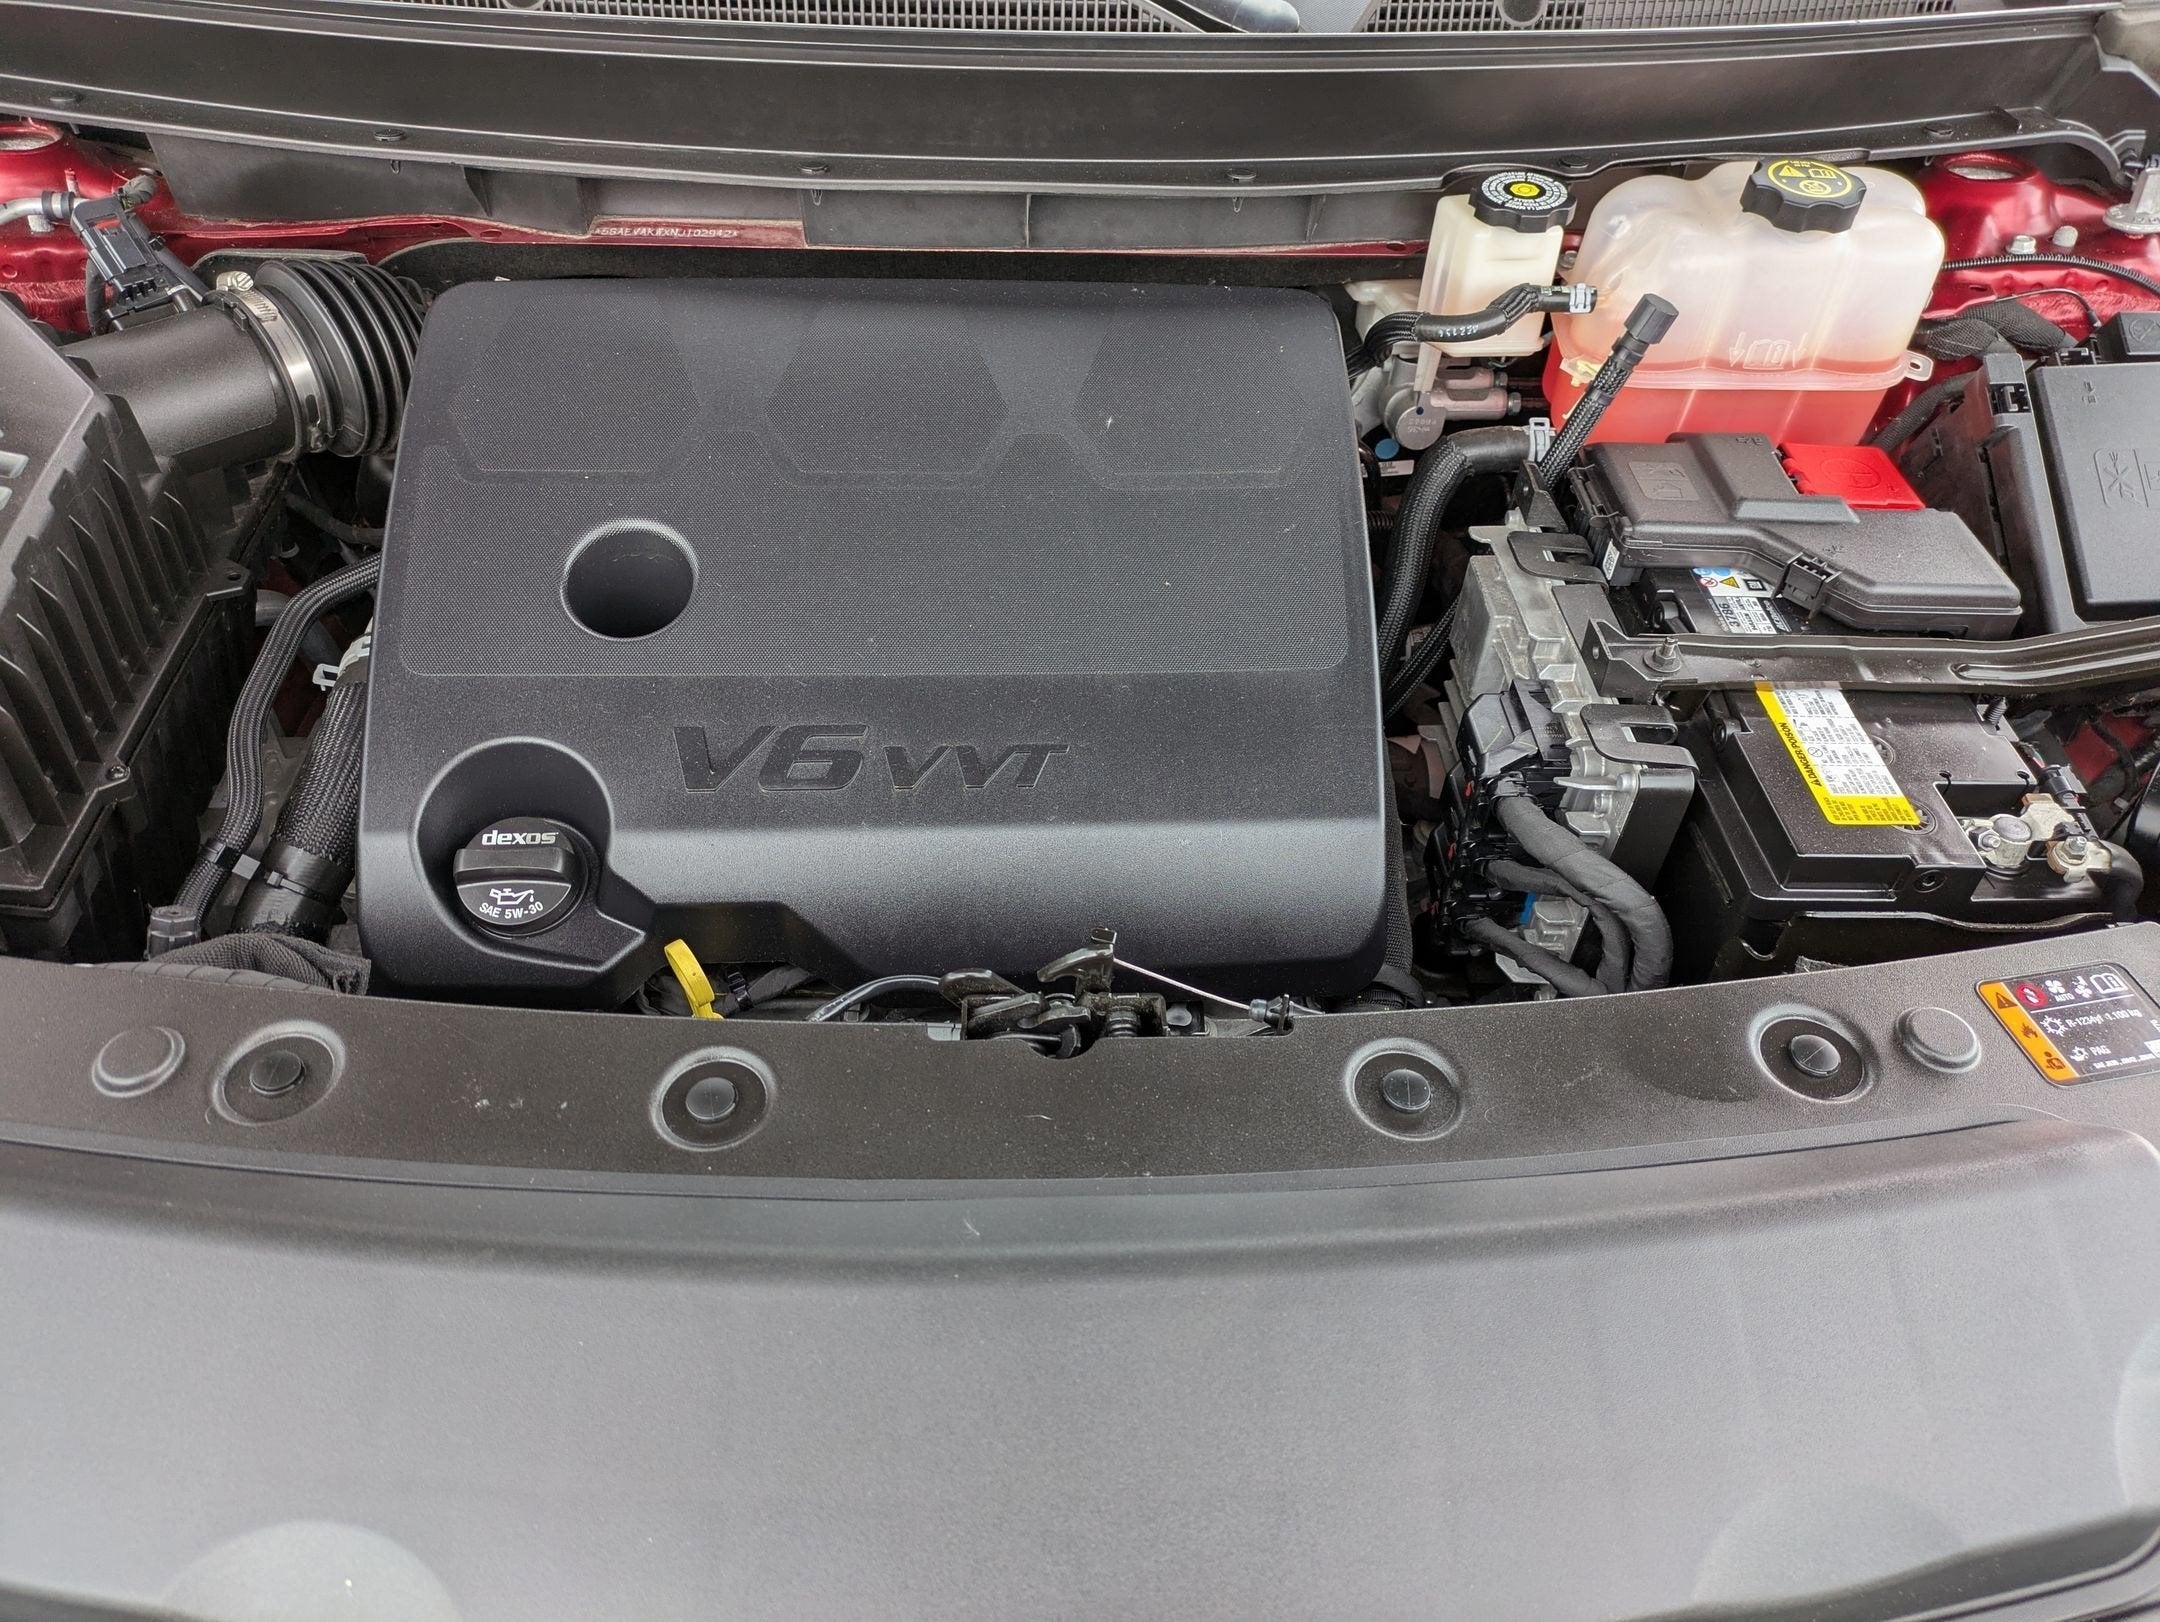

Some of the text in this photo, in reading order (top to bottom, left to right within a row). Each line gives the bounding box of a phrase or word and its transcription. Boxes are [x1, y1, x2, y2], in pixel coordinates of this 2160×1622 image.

[1719, 602, 1740, 628] 3786
[673, 724, 1070, 793] V6 VVT
[481, 830, 557, 846] dexos
[479, 901, 544, 919] SAE 5W-30
[2054, 993, 2075, 1003] AUTO
[2089, 1045, 2112, 1056] PAG
